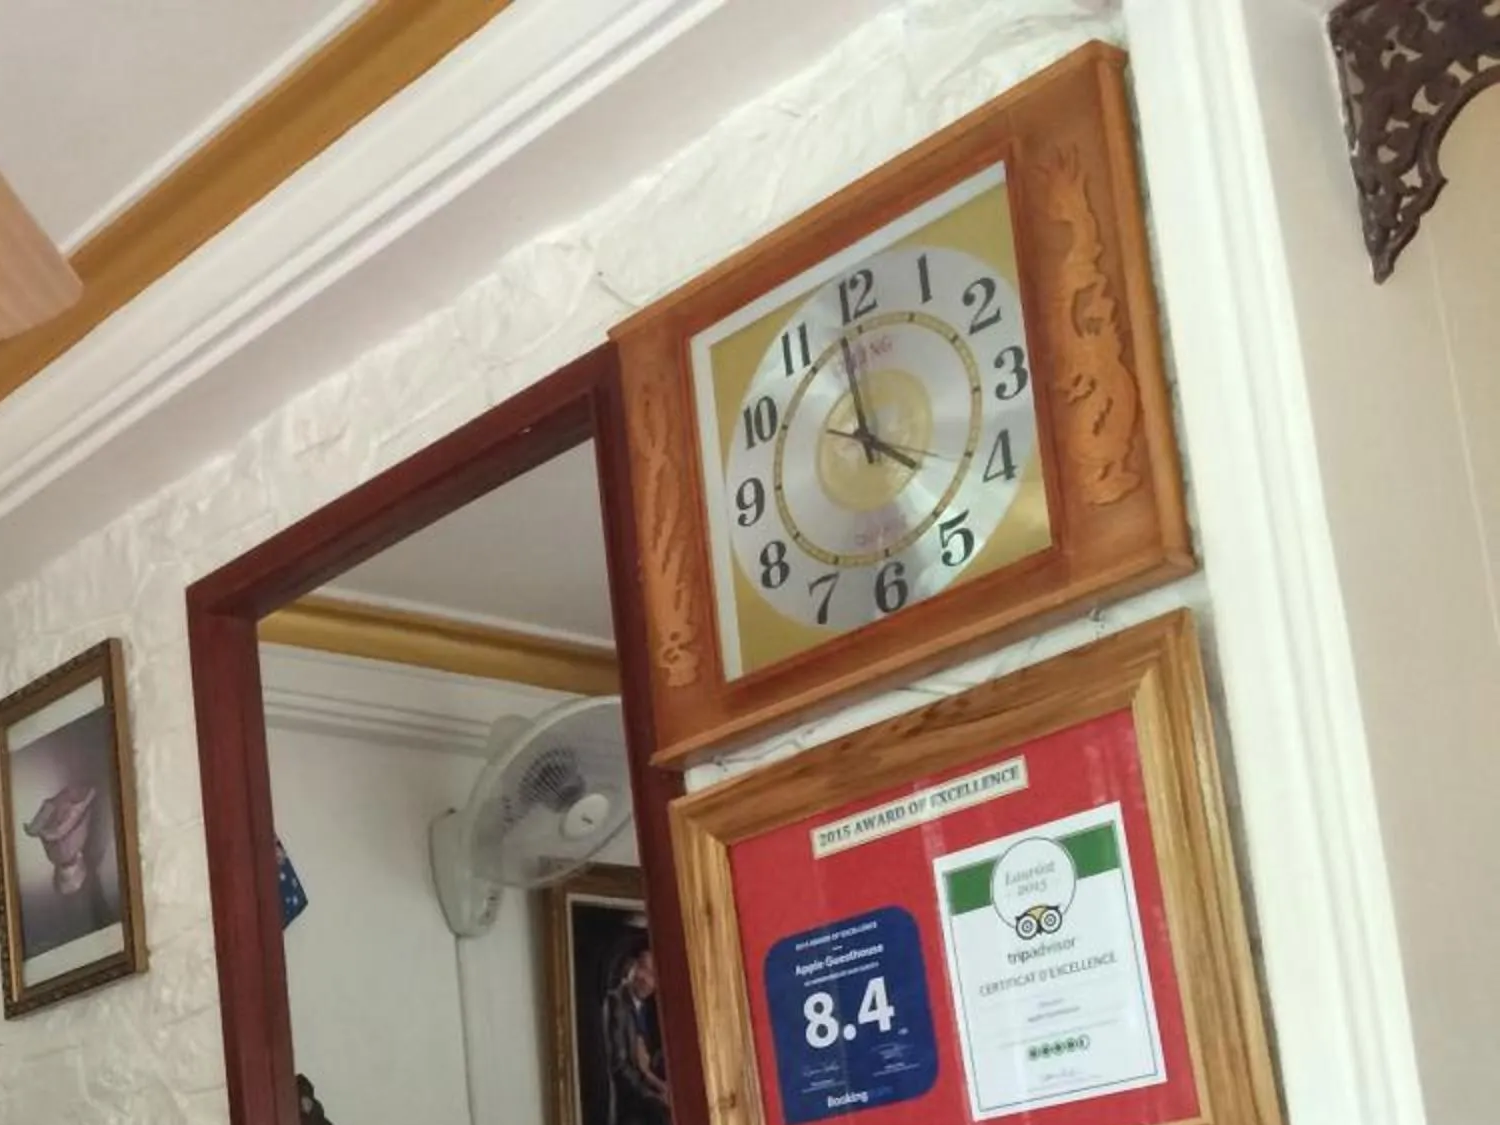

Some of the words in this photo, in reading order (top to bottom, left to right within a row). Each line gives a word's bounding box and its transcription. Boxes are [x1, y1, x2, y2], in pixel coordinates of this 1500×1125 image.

[837, 269, 878, 326] 12
[916, 254, 932, 303] 1
[962, 277, 1003, 335] 2
[781, 322, 811, 377] 11
[994, 345, 1029, 400] 3
[743, 395, 778, 450] 10
[982, 429, 1018, 483] 4
[735, 477, 765, 527] 9
[760, 540, 790, 589] 8
[939, 509, 976, 568] 5
[809, 572, 840, 625] 7
[875, 561, 908, 614] 6
[819, 824, 851, 847] 2015
[854, 806, 906, 834] AWARD
[908, 799, 926, 815] OF
[929, 765, 1020, 809] EXCELLENCE
[1007, 938, 1076, 965] tripadvisor
[803, 976, 895, 1049] 8.4
